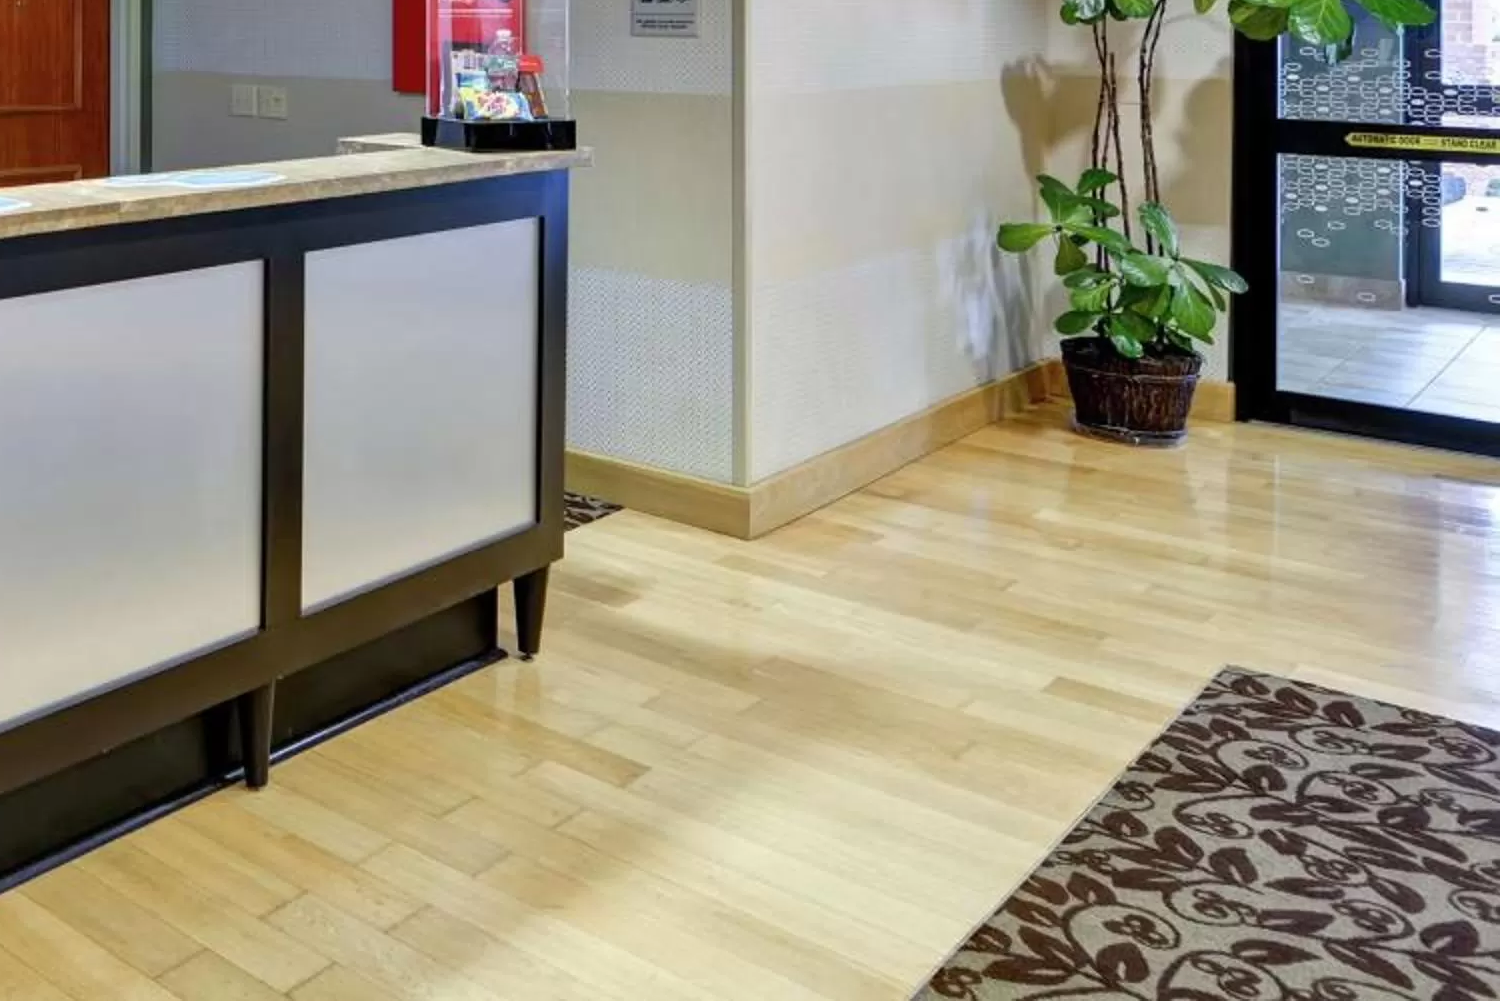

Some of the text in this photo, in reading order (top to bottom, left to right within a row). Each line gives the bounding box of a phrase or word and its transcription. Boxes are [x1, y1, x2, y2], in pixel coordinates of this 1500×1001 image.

[1351, 133, 1497, 150] AUTOMATIC DOOR STAND CLEAR
